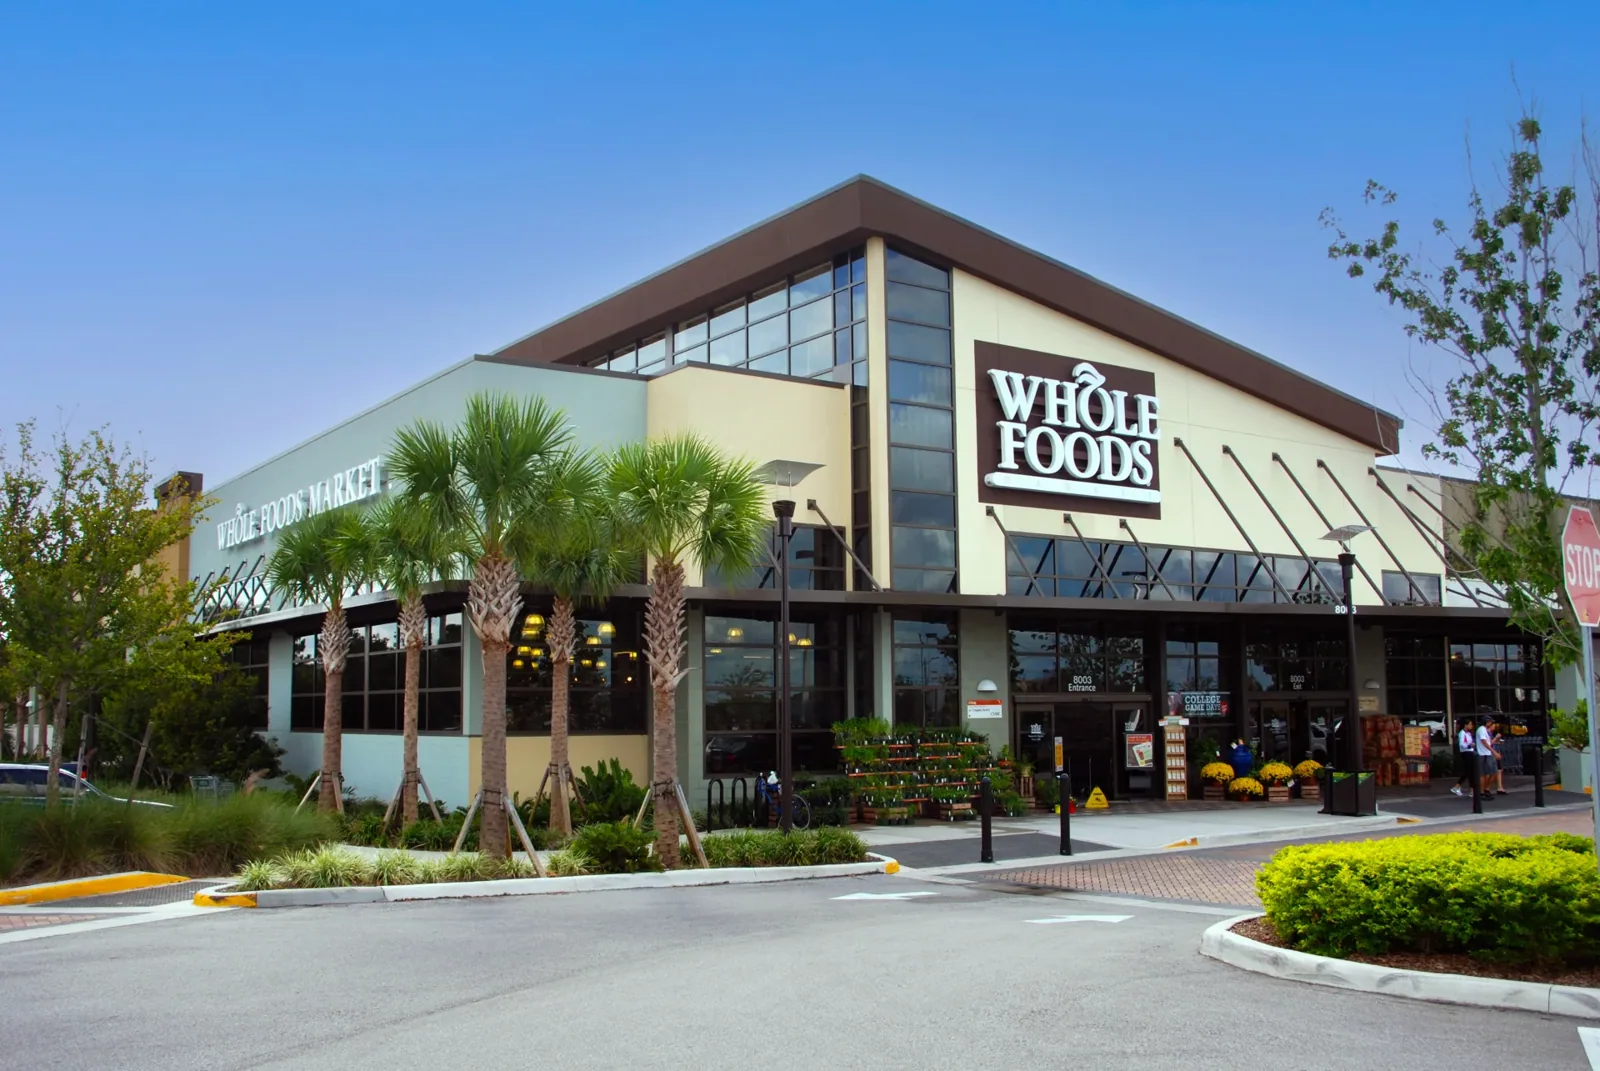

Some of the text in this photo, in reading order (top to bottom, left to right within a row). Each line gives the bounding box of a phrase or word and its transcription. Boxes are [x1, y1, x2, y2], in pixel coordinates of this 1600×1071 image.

[987, 362, 1161, 440] WHOLE
[996, 421, 1153, 486] FOODS
[217, 456, 382, 550] WHOLE FOODS MARKET
[1566, 543, 1600, 588] STOP
[1073, 675, 1092, 684] 8003
[1290, 675, 1305, 683] 8003
[1068, 683, 1096, 692] Entrance
[1293, 682, 1302, 690] Exit
[1184, 695, 1221, 704] COLLEGE
[1185, 703, 1205, 711] GAME
